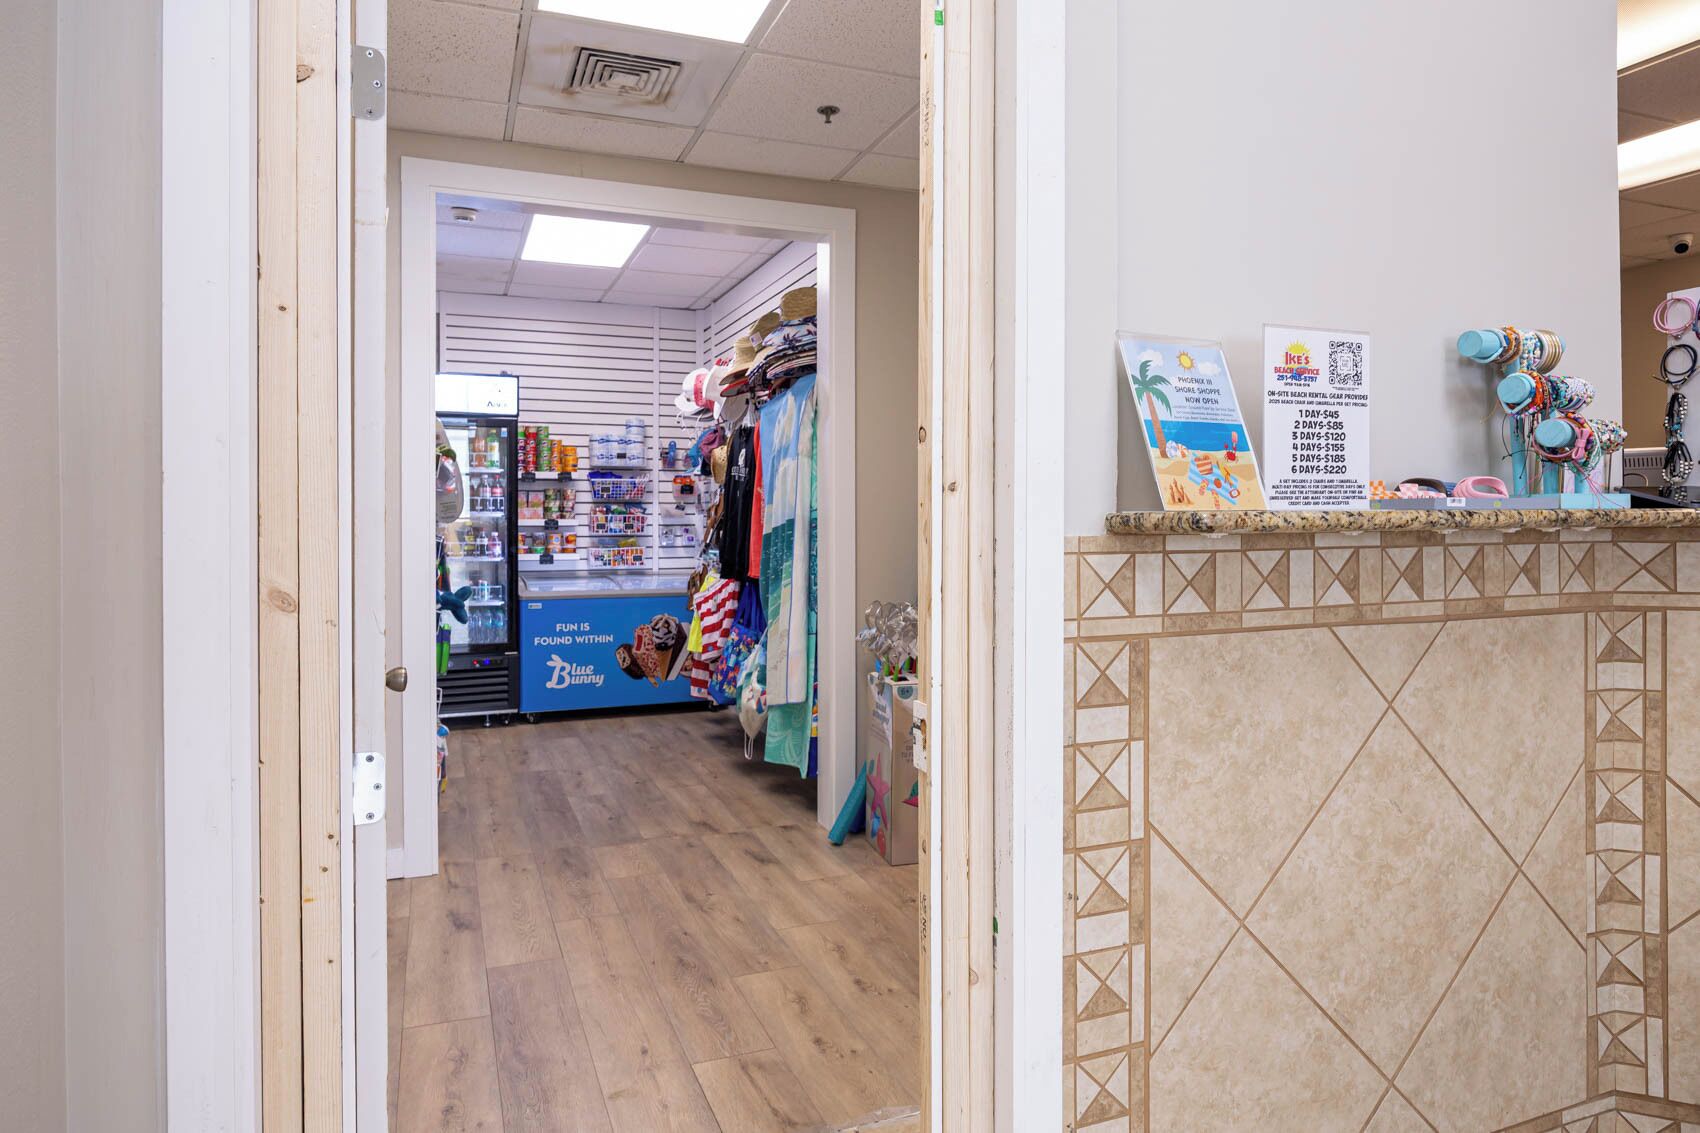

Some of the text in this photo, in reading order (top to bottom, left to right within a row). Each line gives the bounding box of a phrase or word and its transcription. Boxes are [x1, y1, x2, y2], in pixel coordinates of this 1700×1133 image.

[1285, 351, 1310, 365] IKE'S
[1296, 367, 1320, 376] SERVICE
[1305, 410, 1340, 419] DAY-$45
[1294, 420, 1344, 430] 2 DAYS-$85
[1292, 432, 1346, 441] 3 DAYS-$120
[1292, 443, 1345, 452] 4 DAYS-$155
[1292, 454, 1346, 463] 5 DAYS-$185
[1291, 465, 1347, 474] 6 DAYS-$220
[556, 622, 590, 632] FUN IS
[534, 635, 613, 646] FOUND WITHIN
